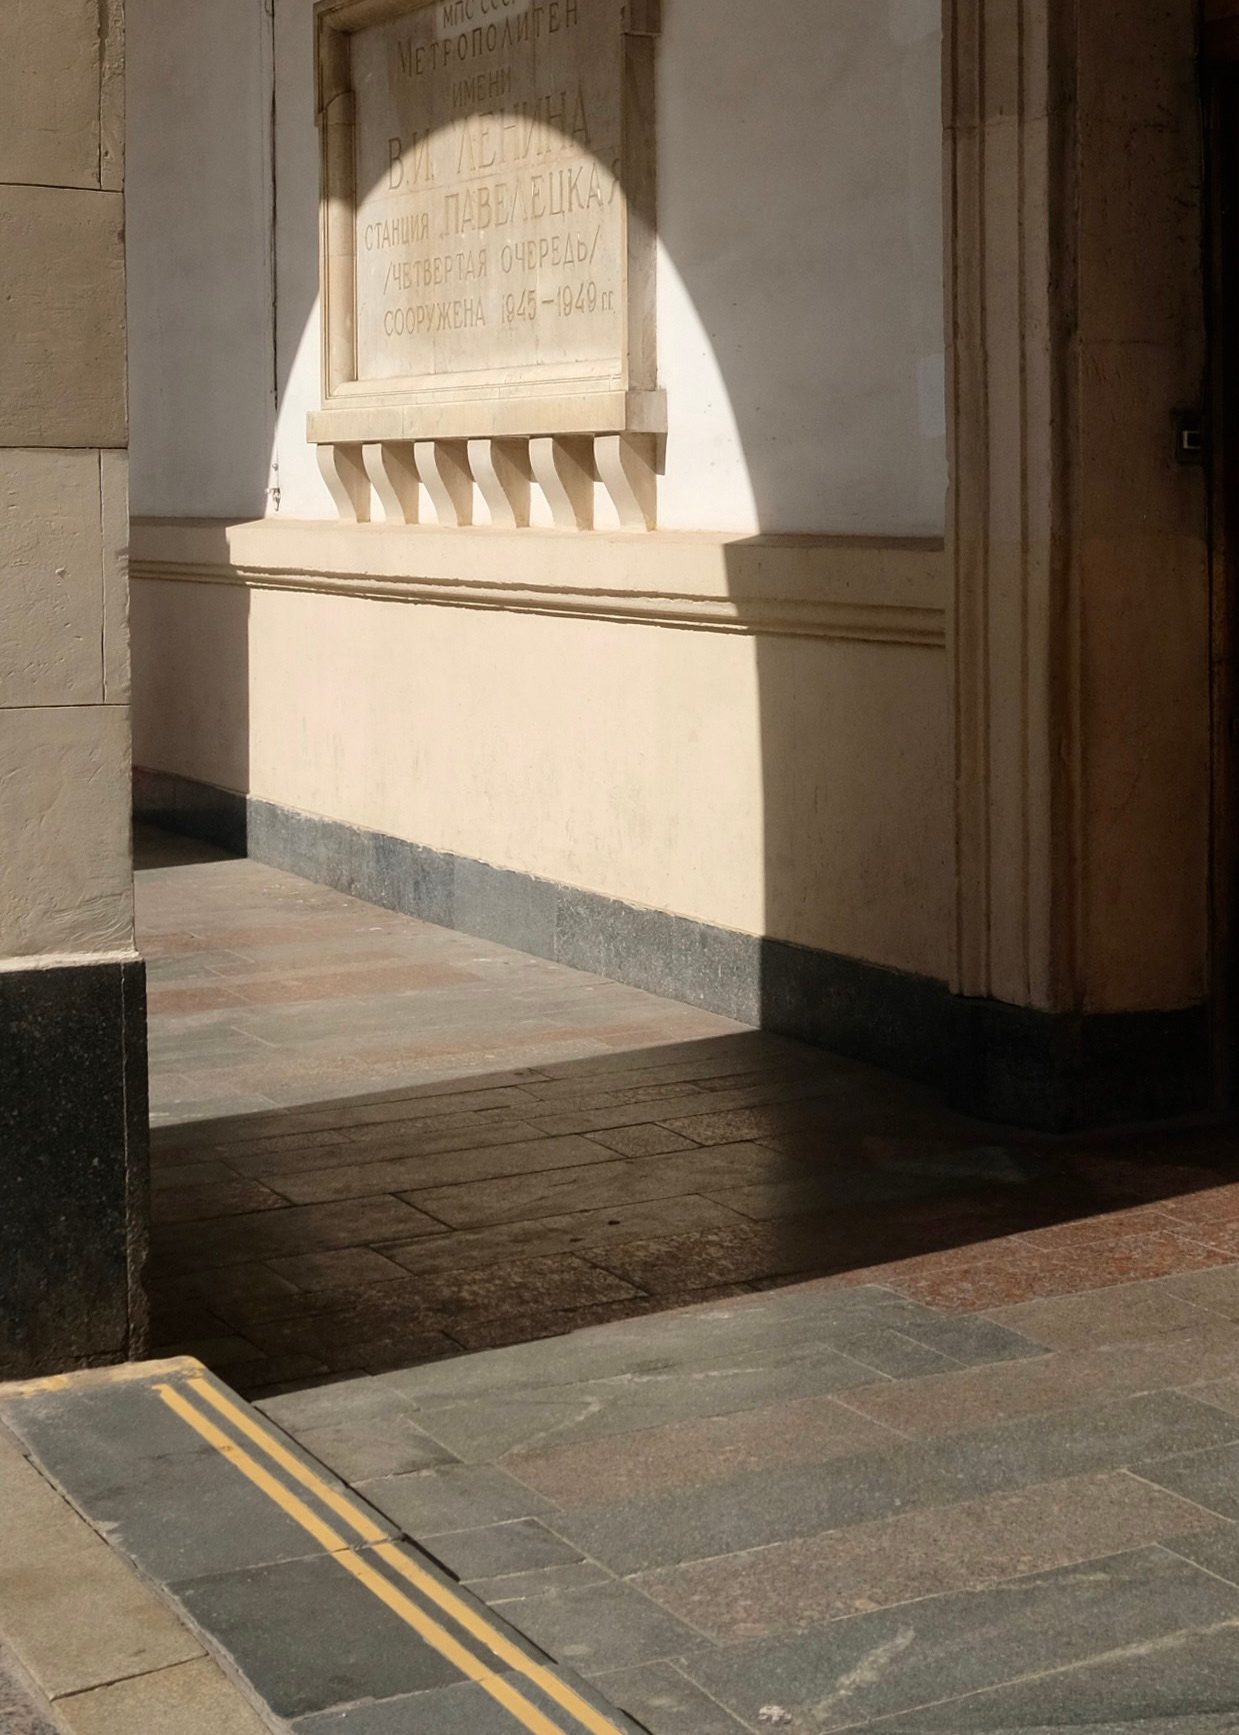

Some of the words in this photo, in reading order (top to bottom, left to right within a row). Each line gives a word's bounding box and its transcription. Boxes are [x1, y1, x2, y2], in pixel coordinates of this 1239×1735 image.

[452, 67, 512, 108] ИМЕНИ
[450, 78, 591, 175] ЛЕНИНА
[364, 212, 430, 251] СТАНЦИЯ
[384, 297, 486, 337] СООРУЖЕНА
